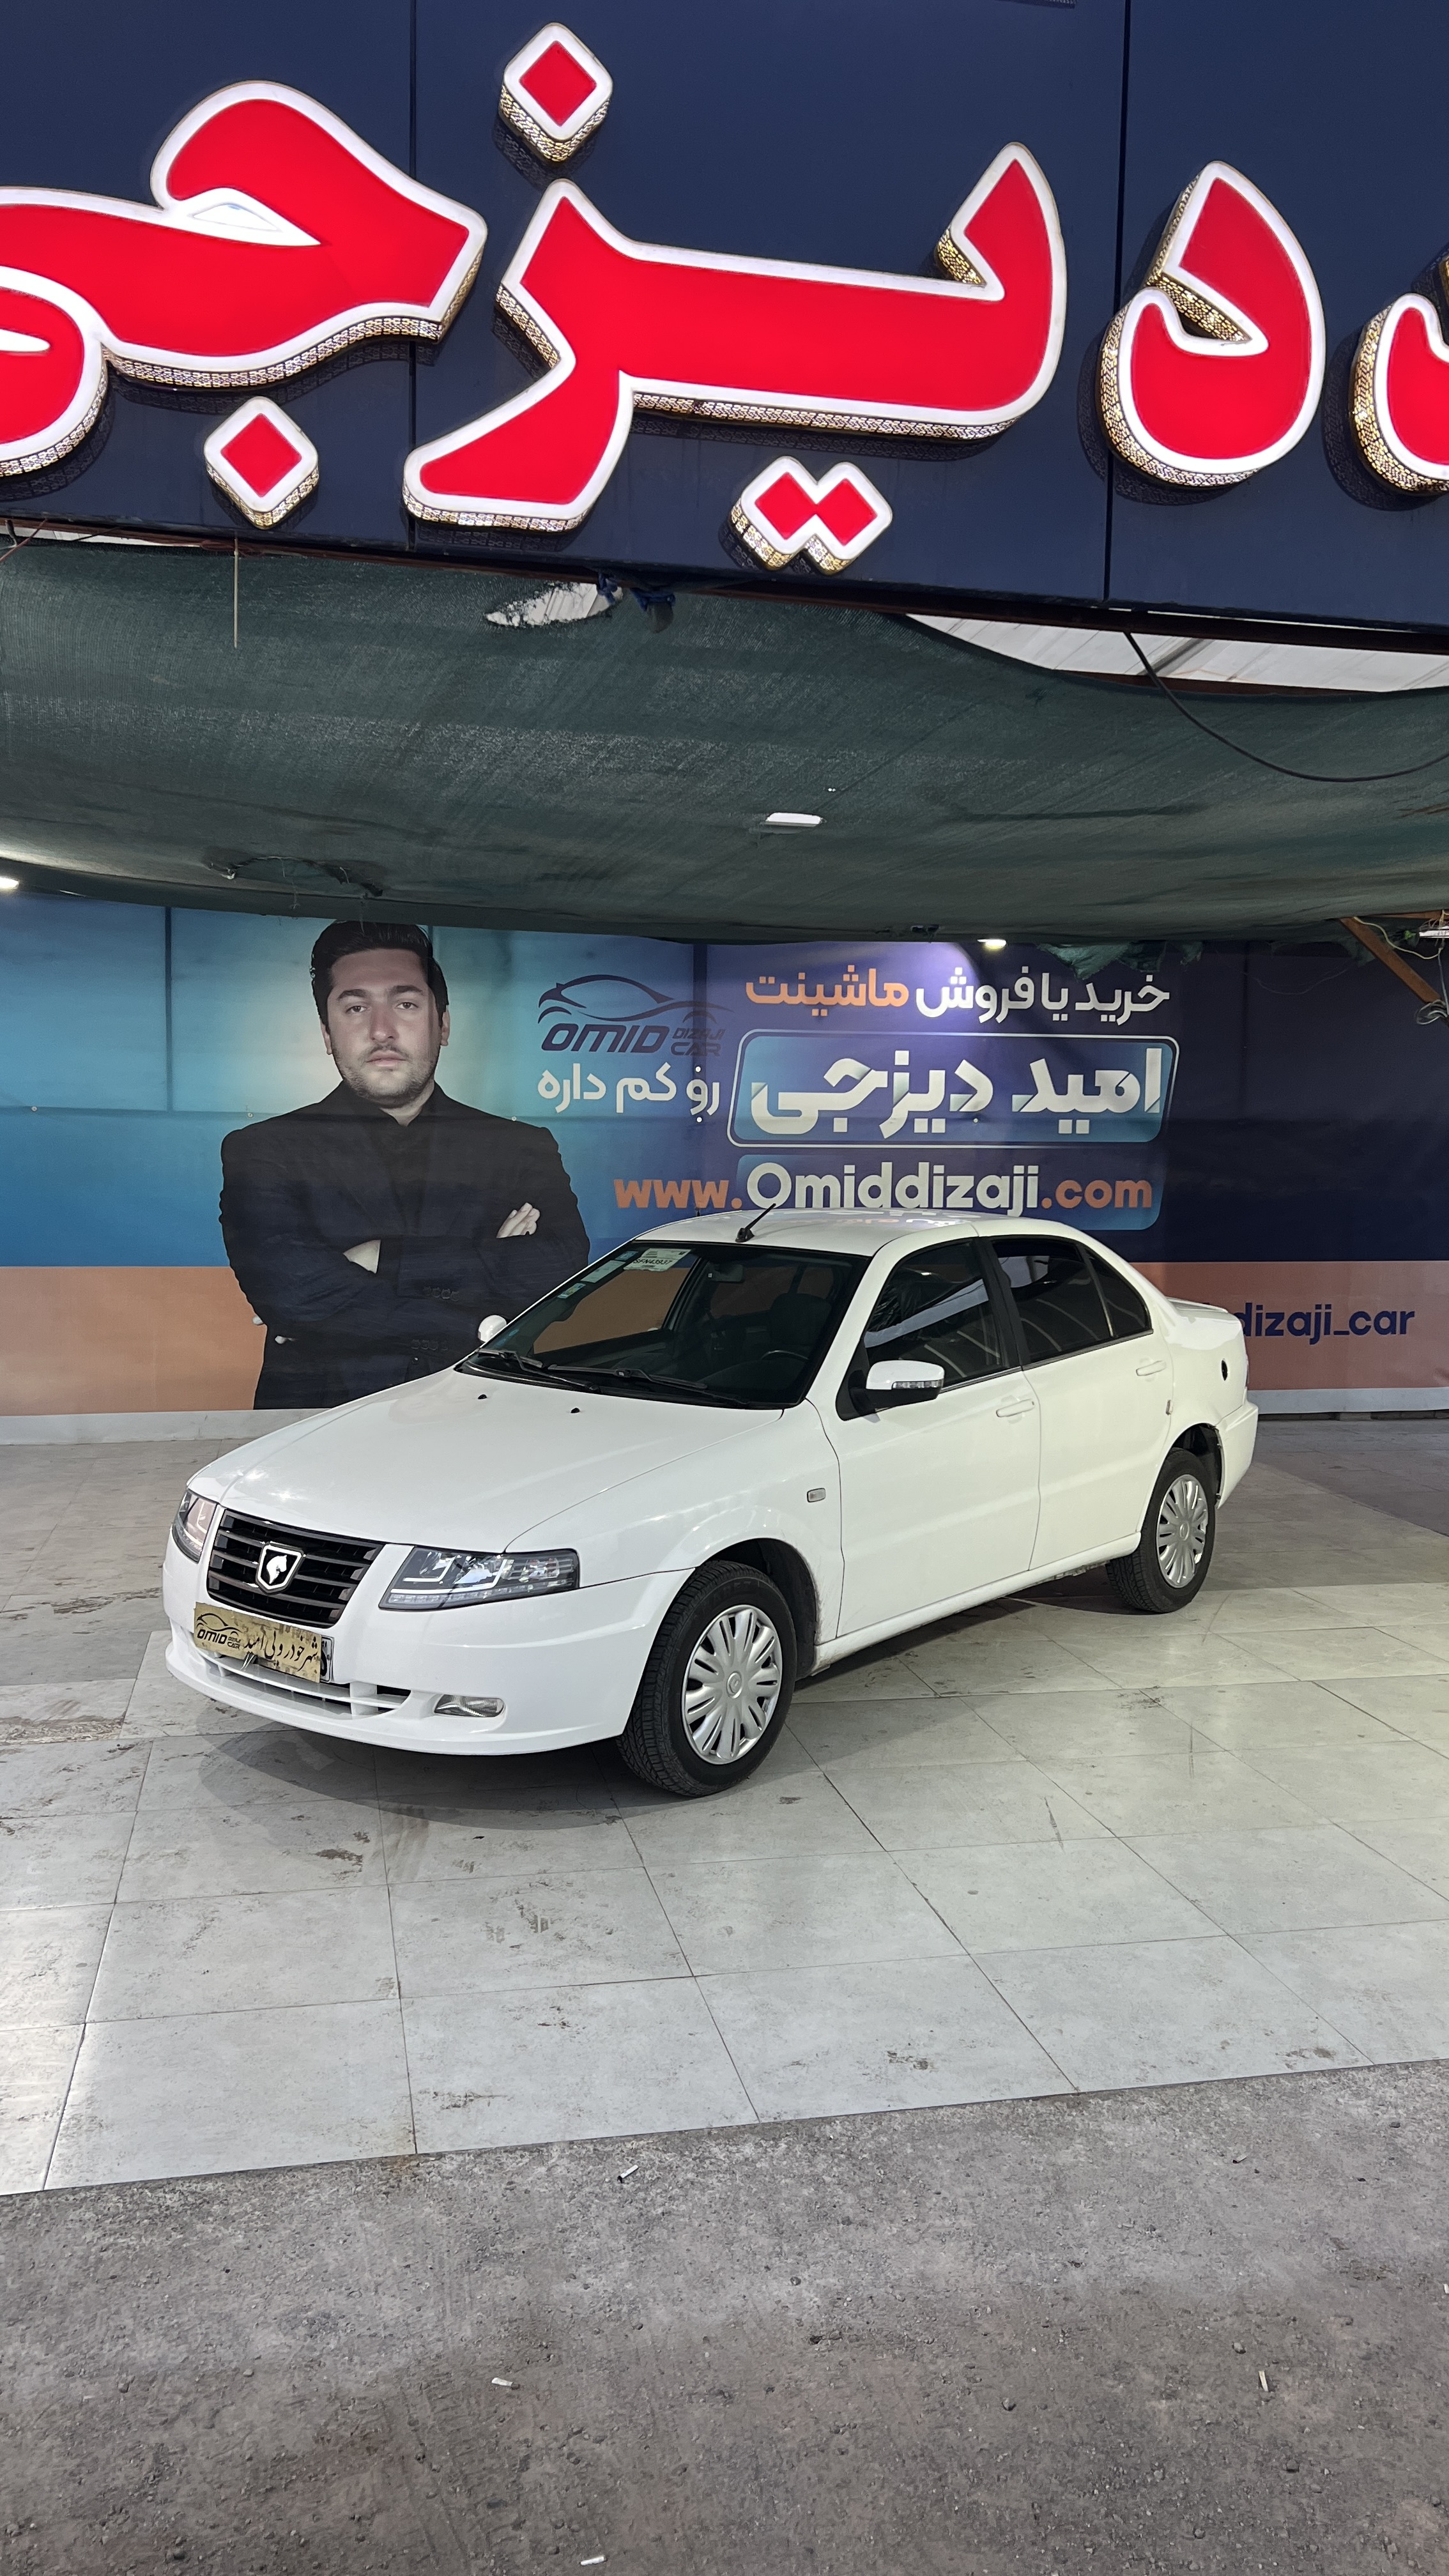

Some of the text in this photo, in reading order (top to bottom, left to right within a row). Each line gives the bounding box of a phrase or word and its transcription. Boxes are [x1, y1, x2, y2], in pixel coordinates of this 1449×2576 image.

[745, 965, 1170, 1026] خرید یا فروش ماشینت
[541, 1023, 670, 1054] OMID
[670, 1042, 721, 1057] CAR
[537, 1062, 607, 1114] داره
[616, 1062, 677, 1114] کم
[751, 1050, 994, 1139] دیزجی
[1011, 1048, 1163, 1135] امید
[613, 1162, 1153, 1217] www.Omiddizaji.com
[1202, 1301, 1415, 1346] dizaji_car
[197, 1629, 227, 1645] OMID
